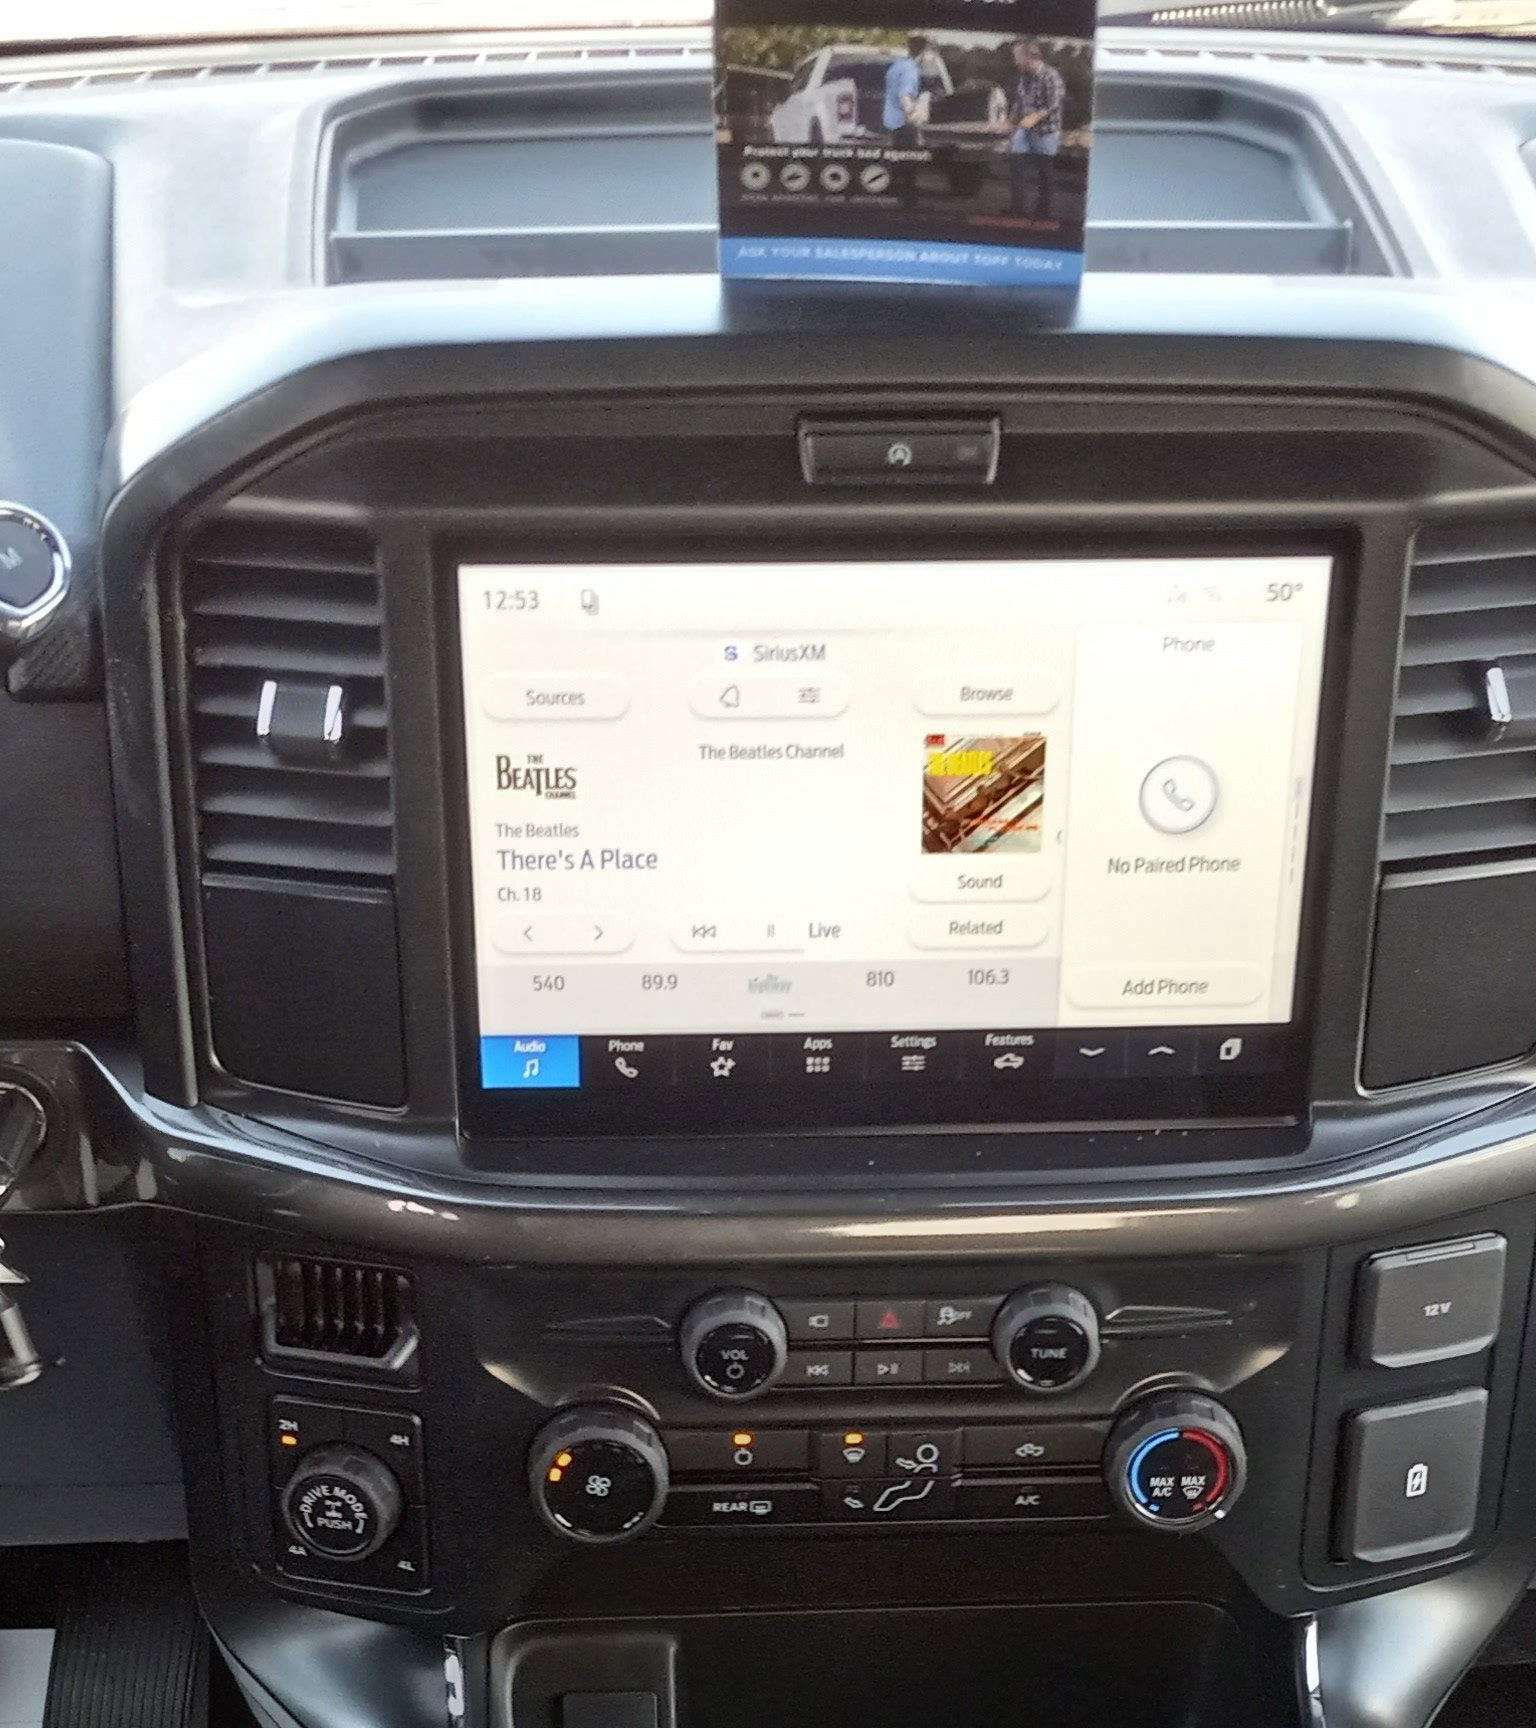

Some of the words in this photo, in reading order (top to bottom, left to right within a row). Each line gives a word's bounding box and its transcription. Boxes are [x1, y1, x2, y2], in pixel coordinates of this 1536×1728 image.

[483, 589, 540, 611] 12:53
[1163, 636, 1216, 652] Phone
[753, 644, 826, 662] SiriusXM
[525, 690, 585, 706] Sources
[960, 685, 1014, 702] Browse
[699, 745, 726, 759] The
[729, 744, 783, 760] Beatles
[785, 743, 844, 760] Channel
[496, 823, 523, 838] The
[525, 823, 580, 838] Beatles
[497, 850, 575, 871] There's
[579, 850, 595, 870] A
[600, 849, 658, 870] Place
[1107, 857, 1130, 874] No
[1134, 857, 1186, 874] Paired
[1190, 856, 1241, 874] Phone
[957, 875, 1003, 890] Sound
[498, 887, 520, 902] Ch.
[809, 923, 841, 939] Live
[948, 920, 1004, 936] Related
[533, 976, 565, 992] 540
[641, 974, 678, 992] 89.9
[866, 971, 895, 988] 810
[967, 969, 1009, 987] 106.3
[1122, 979, 1156, 996] Add
[1159, 979, 1209, 996] Phone
[514, 1040, 546, 1053] Audio
[608, 1040, 645, 1053] Phone
[712, 1038, 734, 1051] Fav
[804, 1037, 833, 1051] Apps
[891, 1034, 937, 1050] Settings
[984, 1033, 1034, 1047] Features
[1424, 1301, 1452, 1317] 12V
[721, 1349, 748, 1361] VOL
[1031, 1348, 1068, 1360] TUNE
[1149, 1477, 1175, 1487] MAX
[1181, 1475, 1207, 1486] MAX
[299, 1485, 334, 1514] DRIVE
[332, 1486, 369, 1520] MODE
[713, 1501, 748, 1513] REAR
[1015, 1493, 1041, 1506] A/C
[316, 1516, 353, 1531] PUSH
